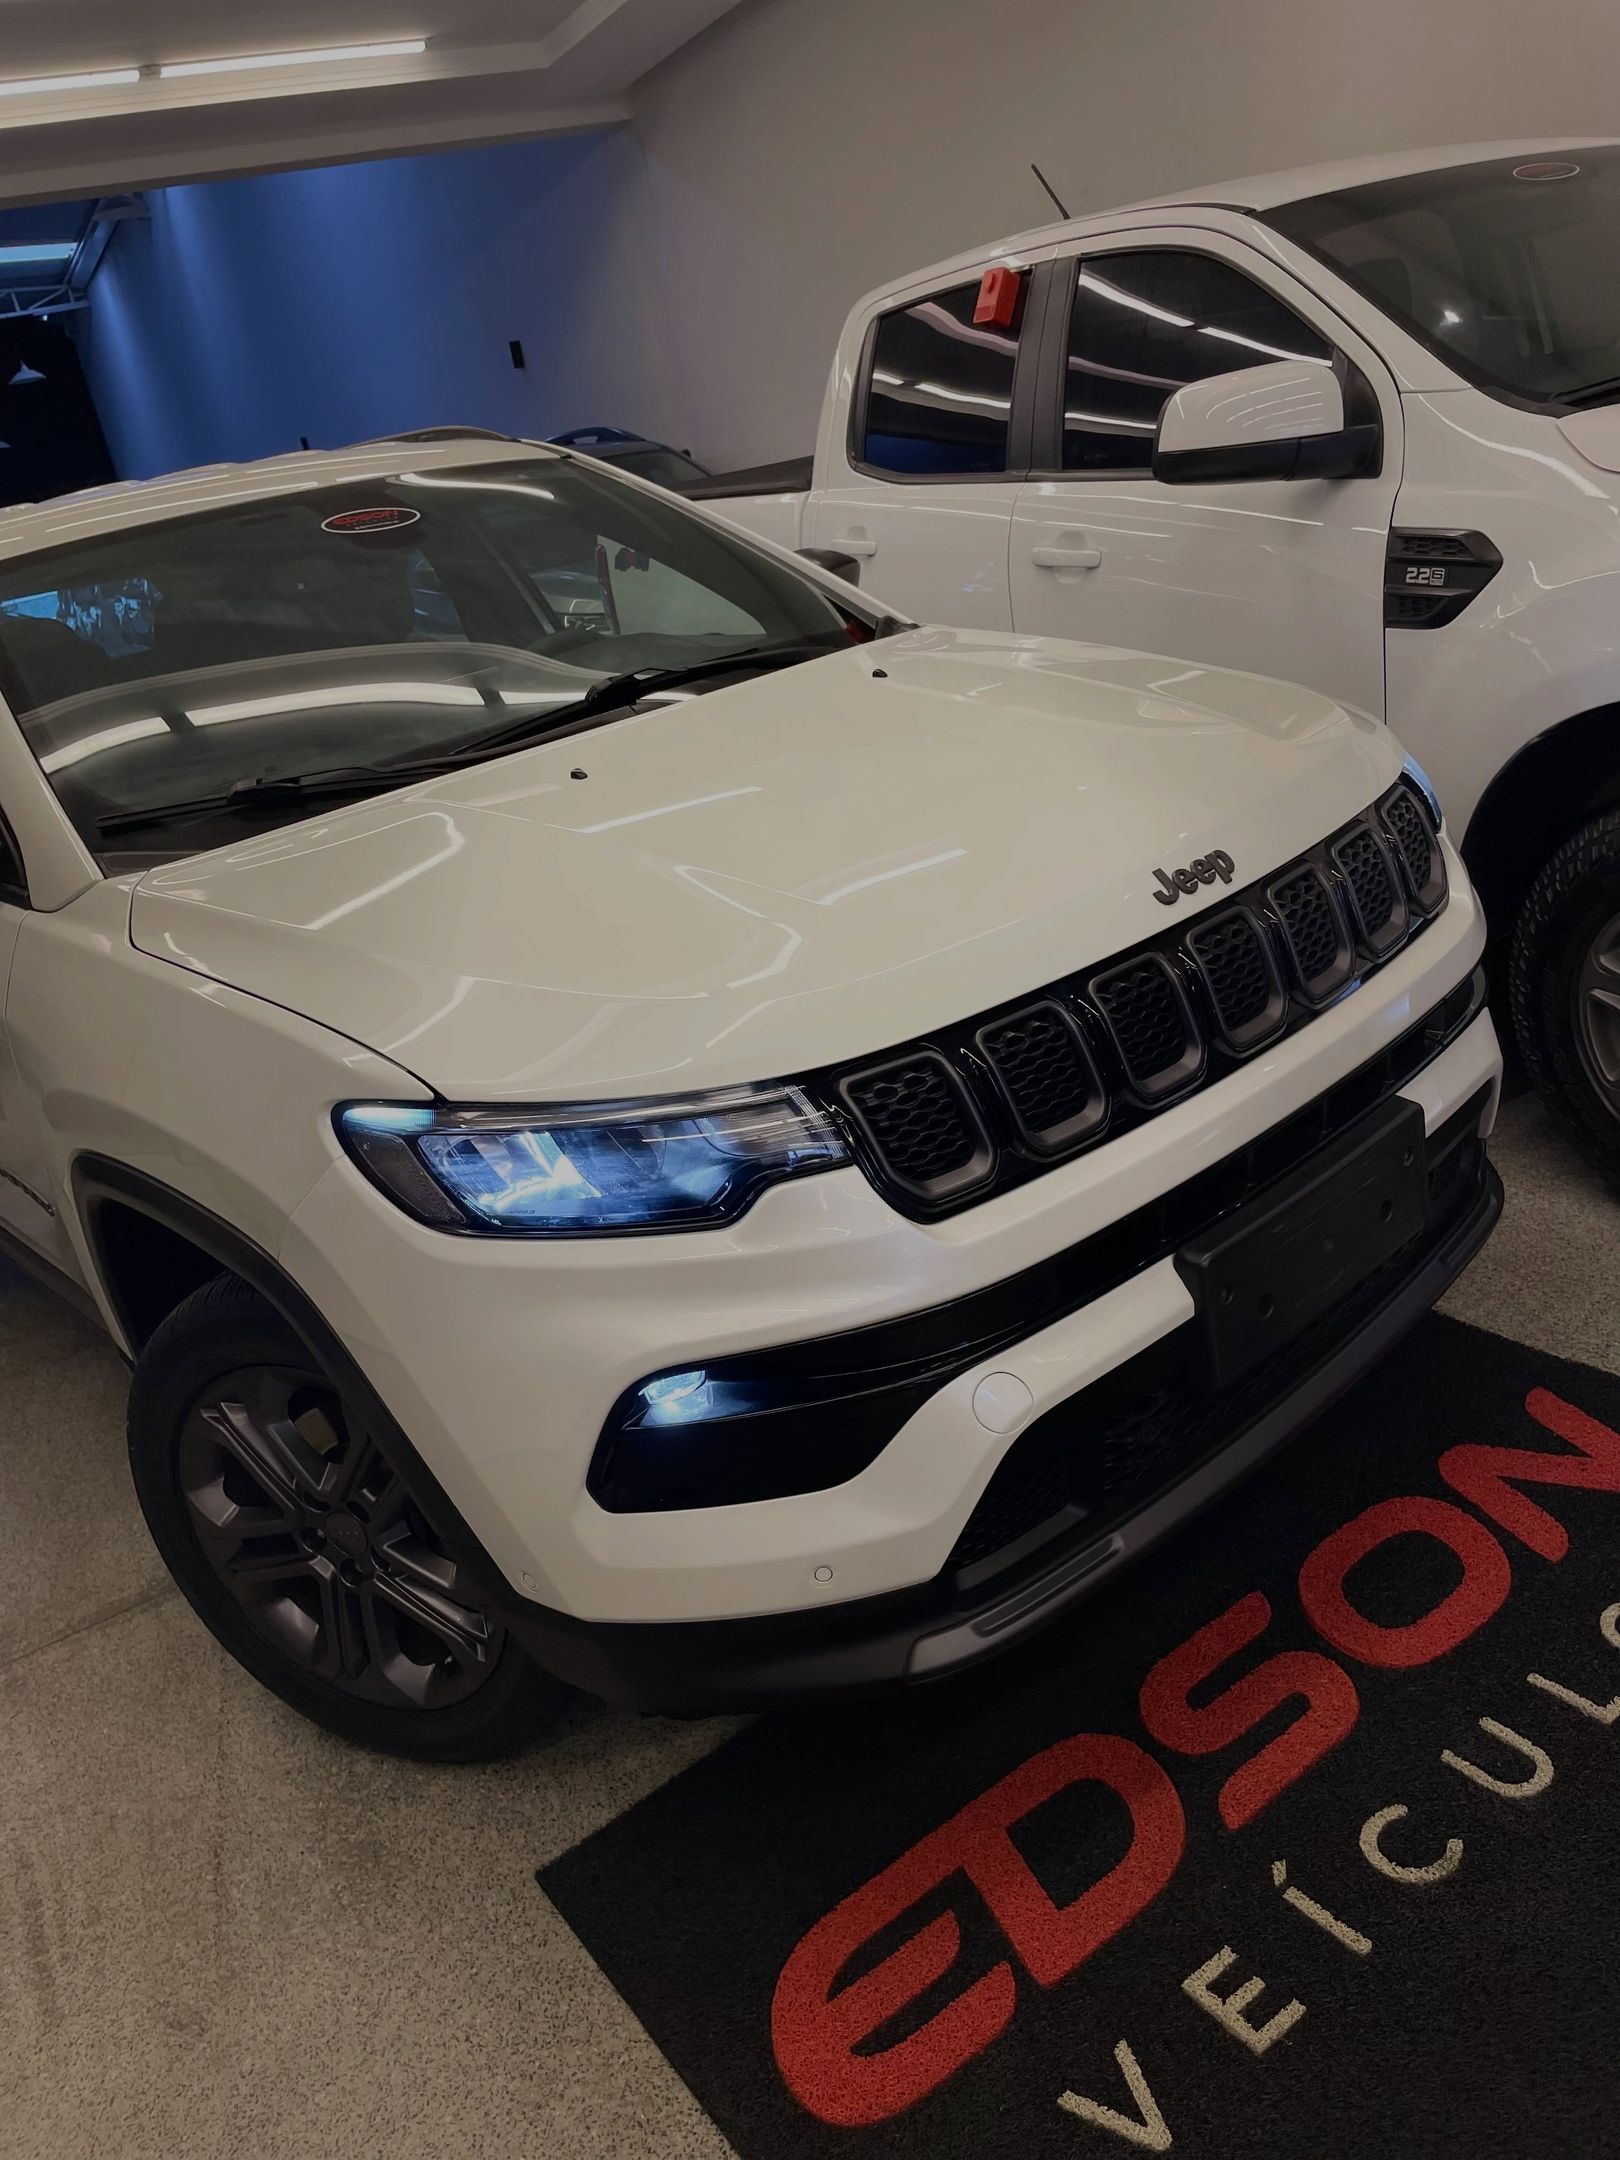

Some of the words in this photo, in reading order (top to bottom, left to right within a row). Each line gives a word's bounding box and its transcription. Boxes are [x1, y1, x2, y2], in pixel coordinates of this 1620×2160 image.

[1152, 849, 1235, 906] Jeep
[771, 1385, 1620, 2129] EDSON
[1056, 1601, 1620, 2152] VEÍCUL
